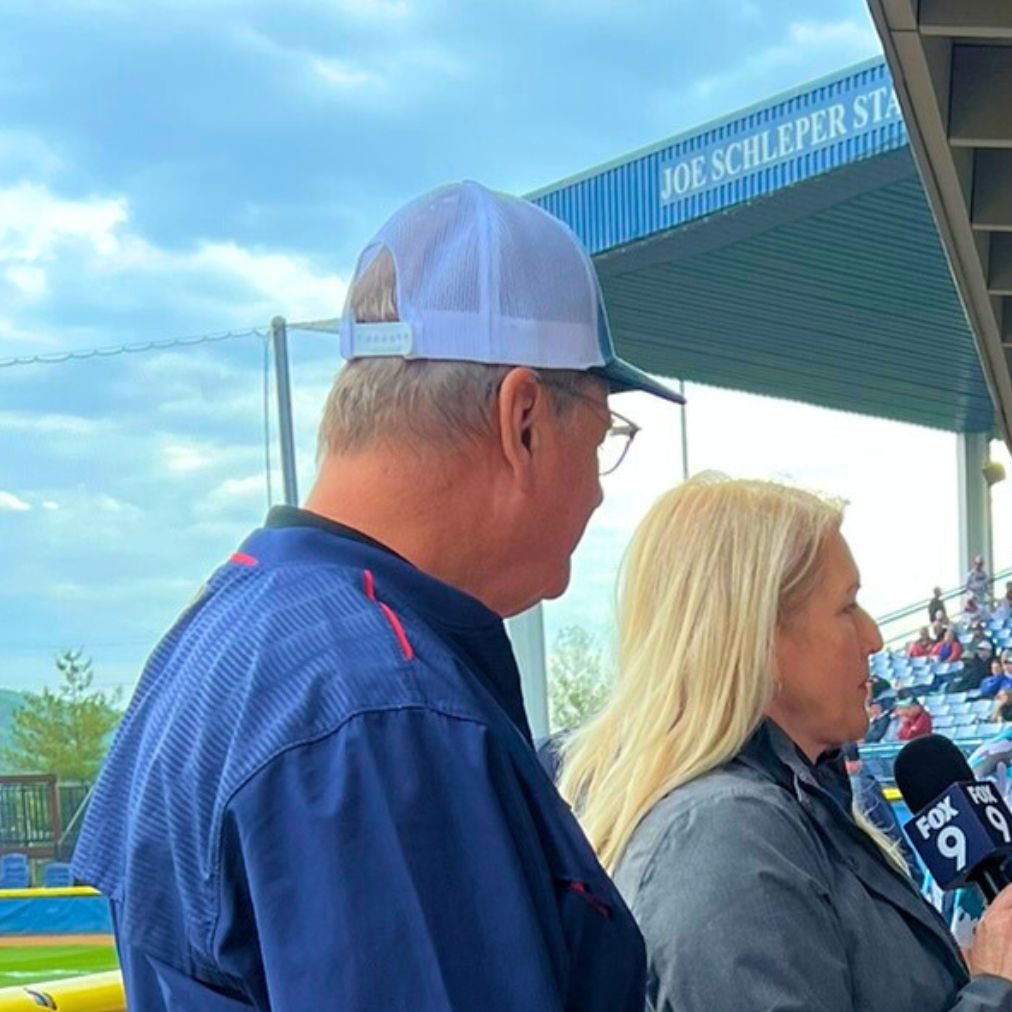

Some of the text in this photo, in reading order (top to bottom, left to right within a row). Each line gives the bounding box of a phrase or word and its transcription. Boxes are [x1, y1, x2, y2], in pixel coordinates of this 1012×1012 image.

[660, 155, 706, 200] JOE
[711, 103, 847, 182] SCHLEPER
[967, 785, 998, 804] FOX
[915, 796, 959, 840] FOX
[985, 805, 1012, 843] 9
[937, 825, 967, 872] 9
